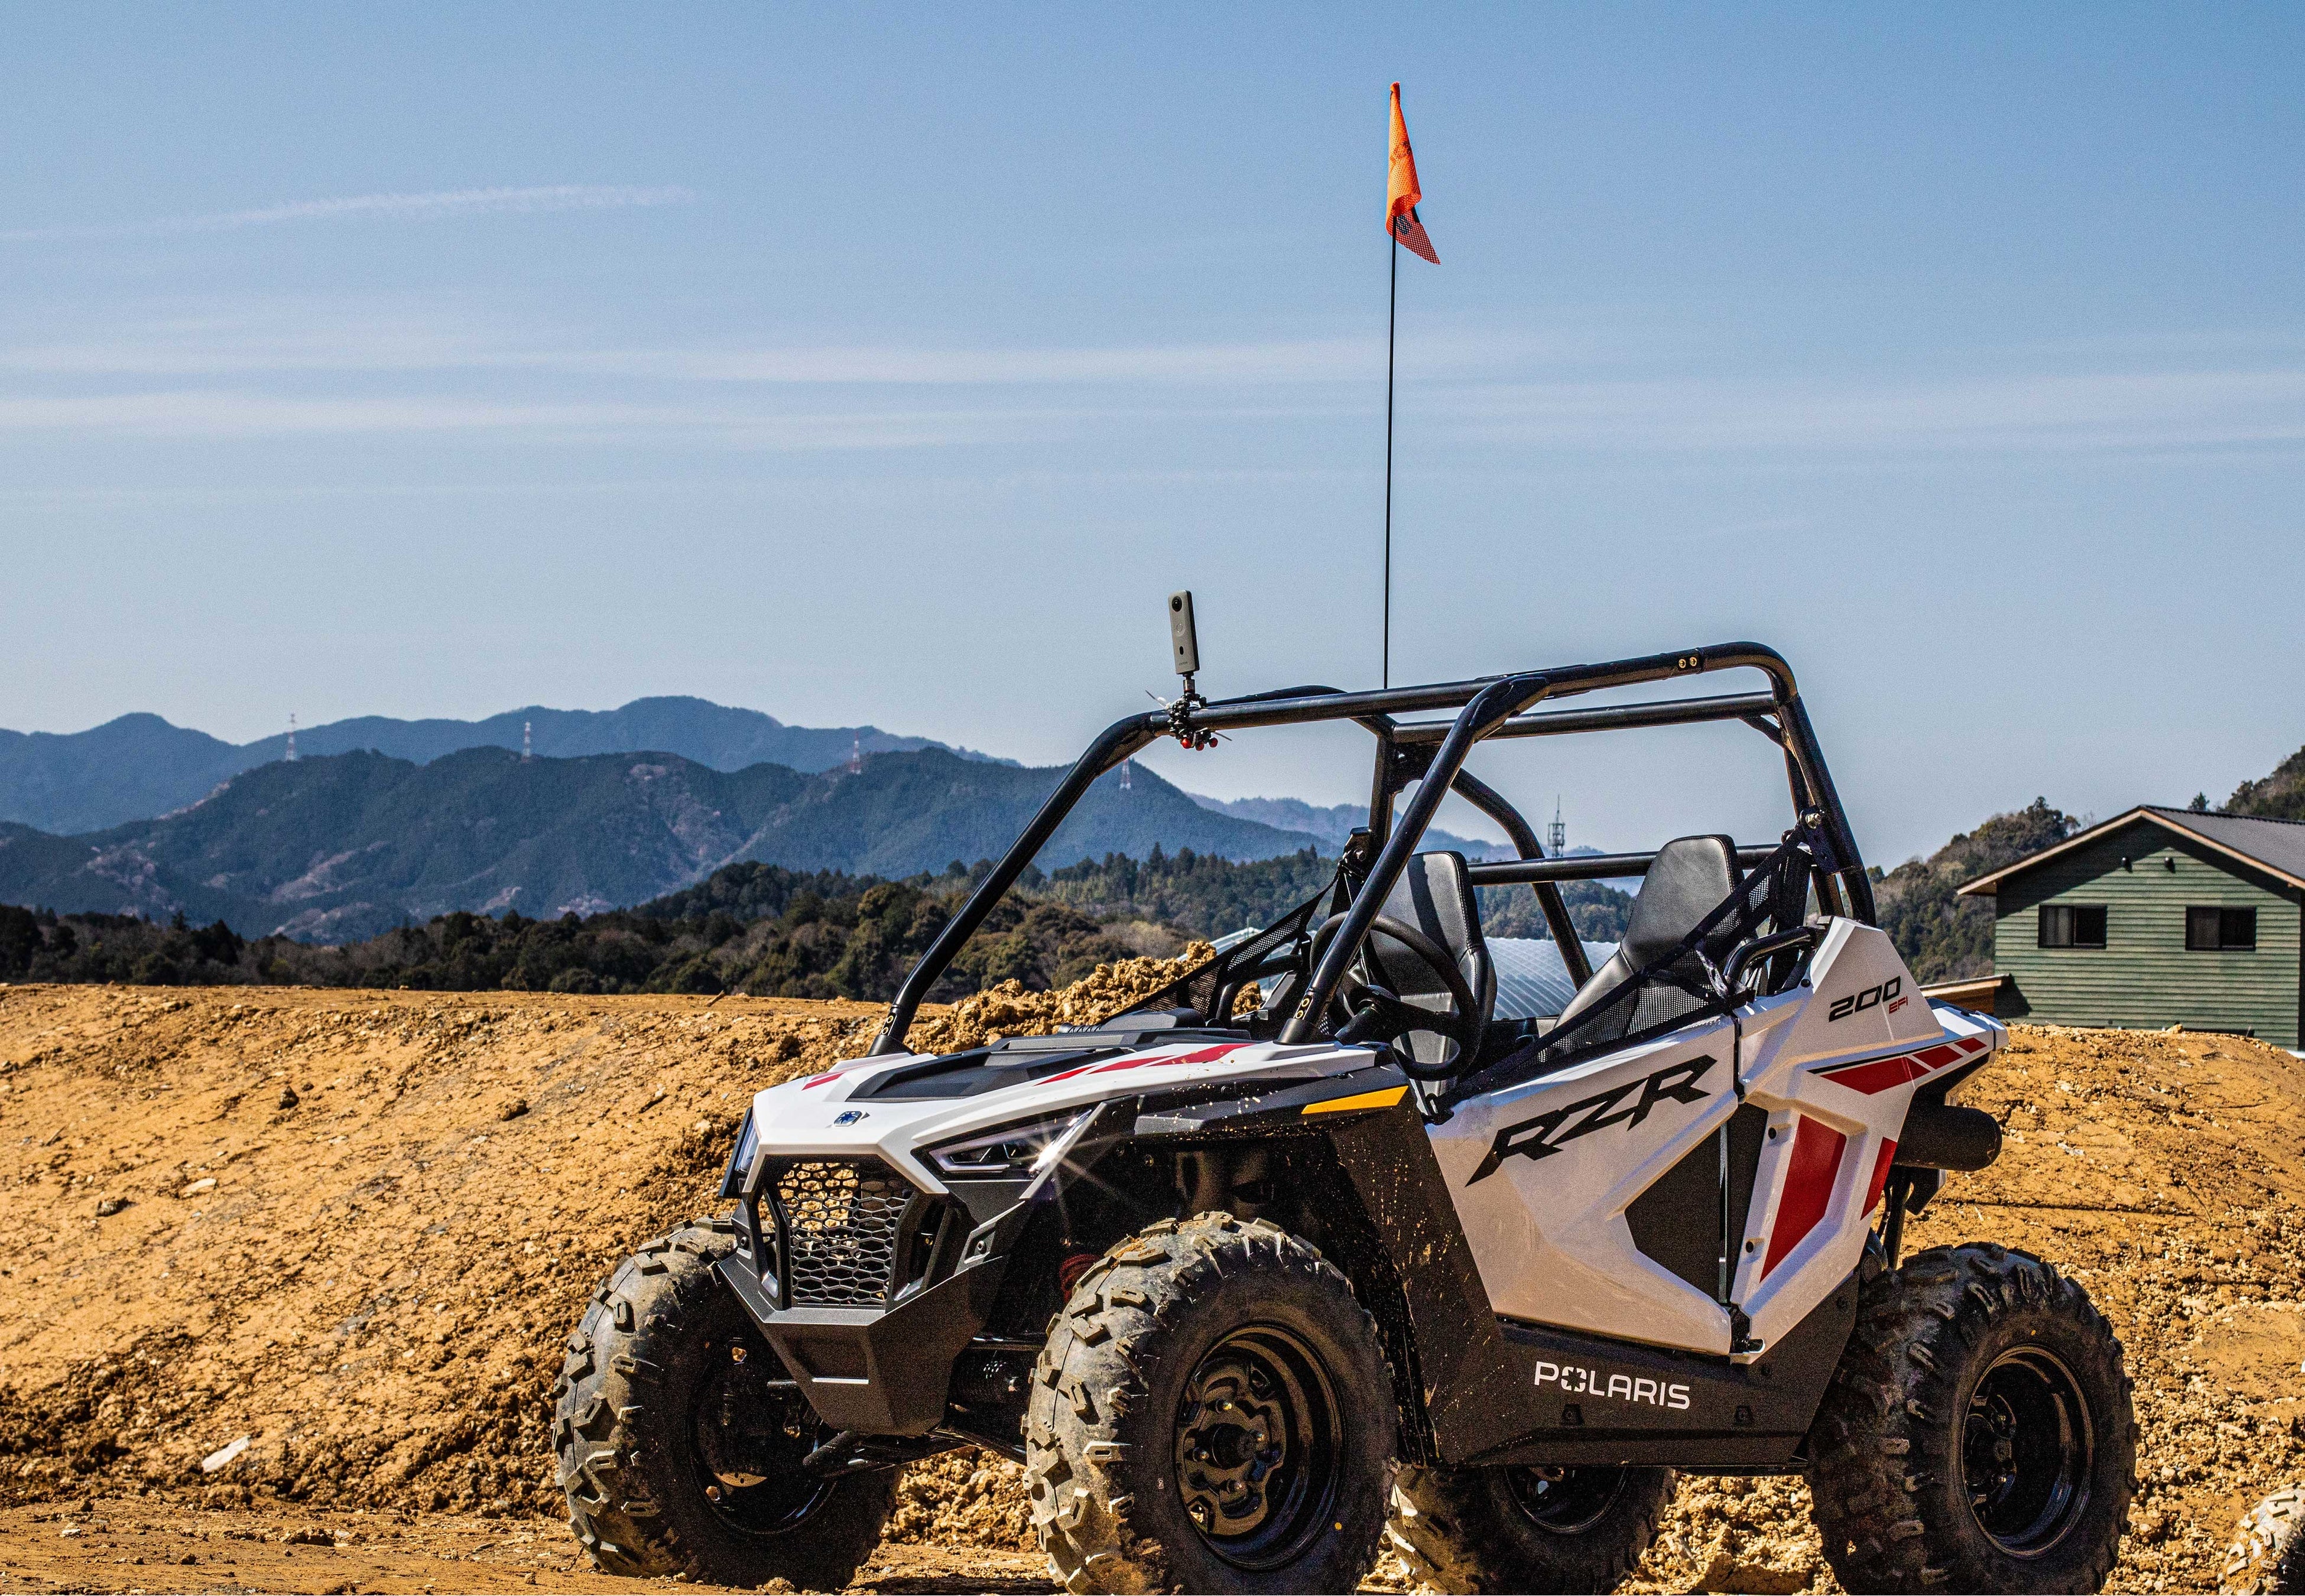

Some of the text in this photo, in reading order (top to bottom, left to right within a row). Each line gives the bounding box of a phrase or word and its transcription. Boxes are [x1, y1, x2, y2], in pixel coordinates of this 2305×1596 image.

[1829, 976, 1908, 1022] 200 EFI
[1465, 1054, 1718, 1187] RZR
[1534, 1361, 1690, 1410] POLARIS
